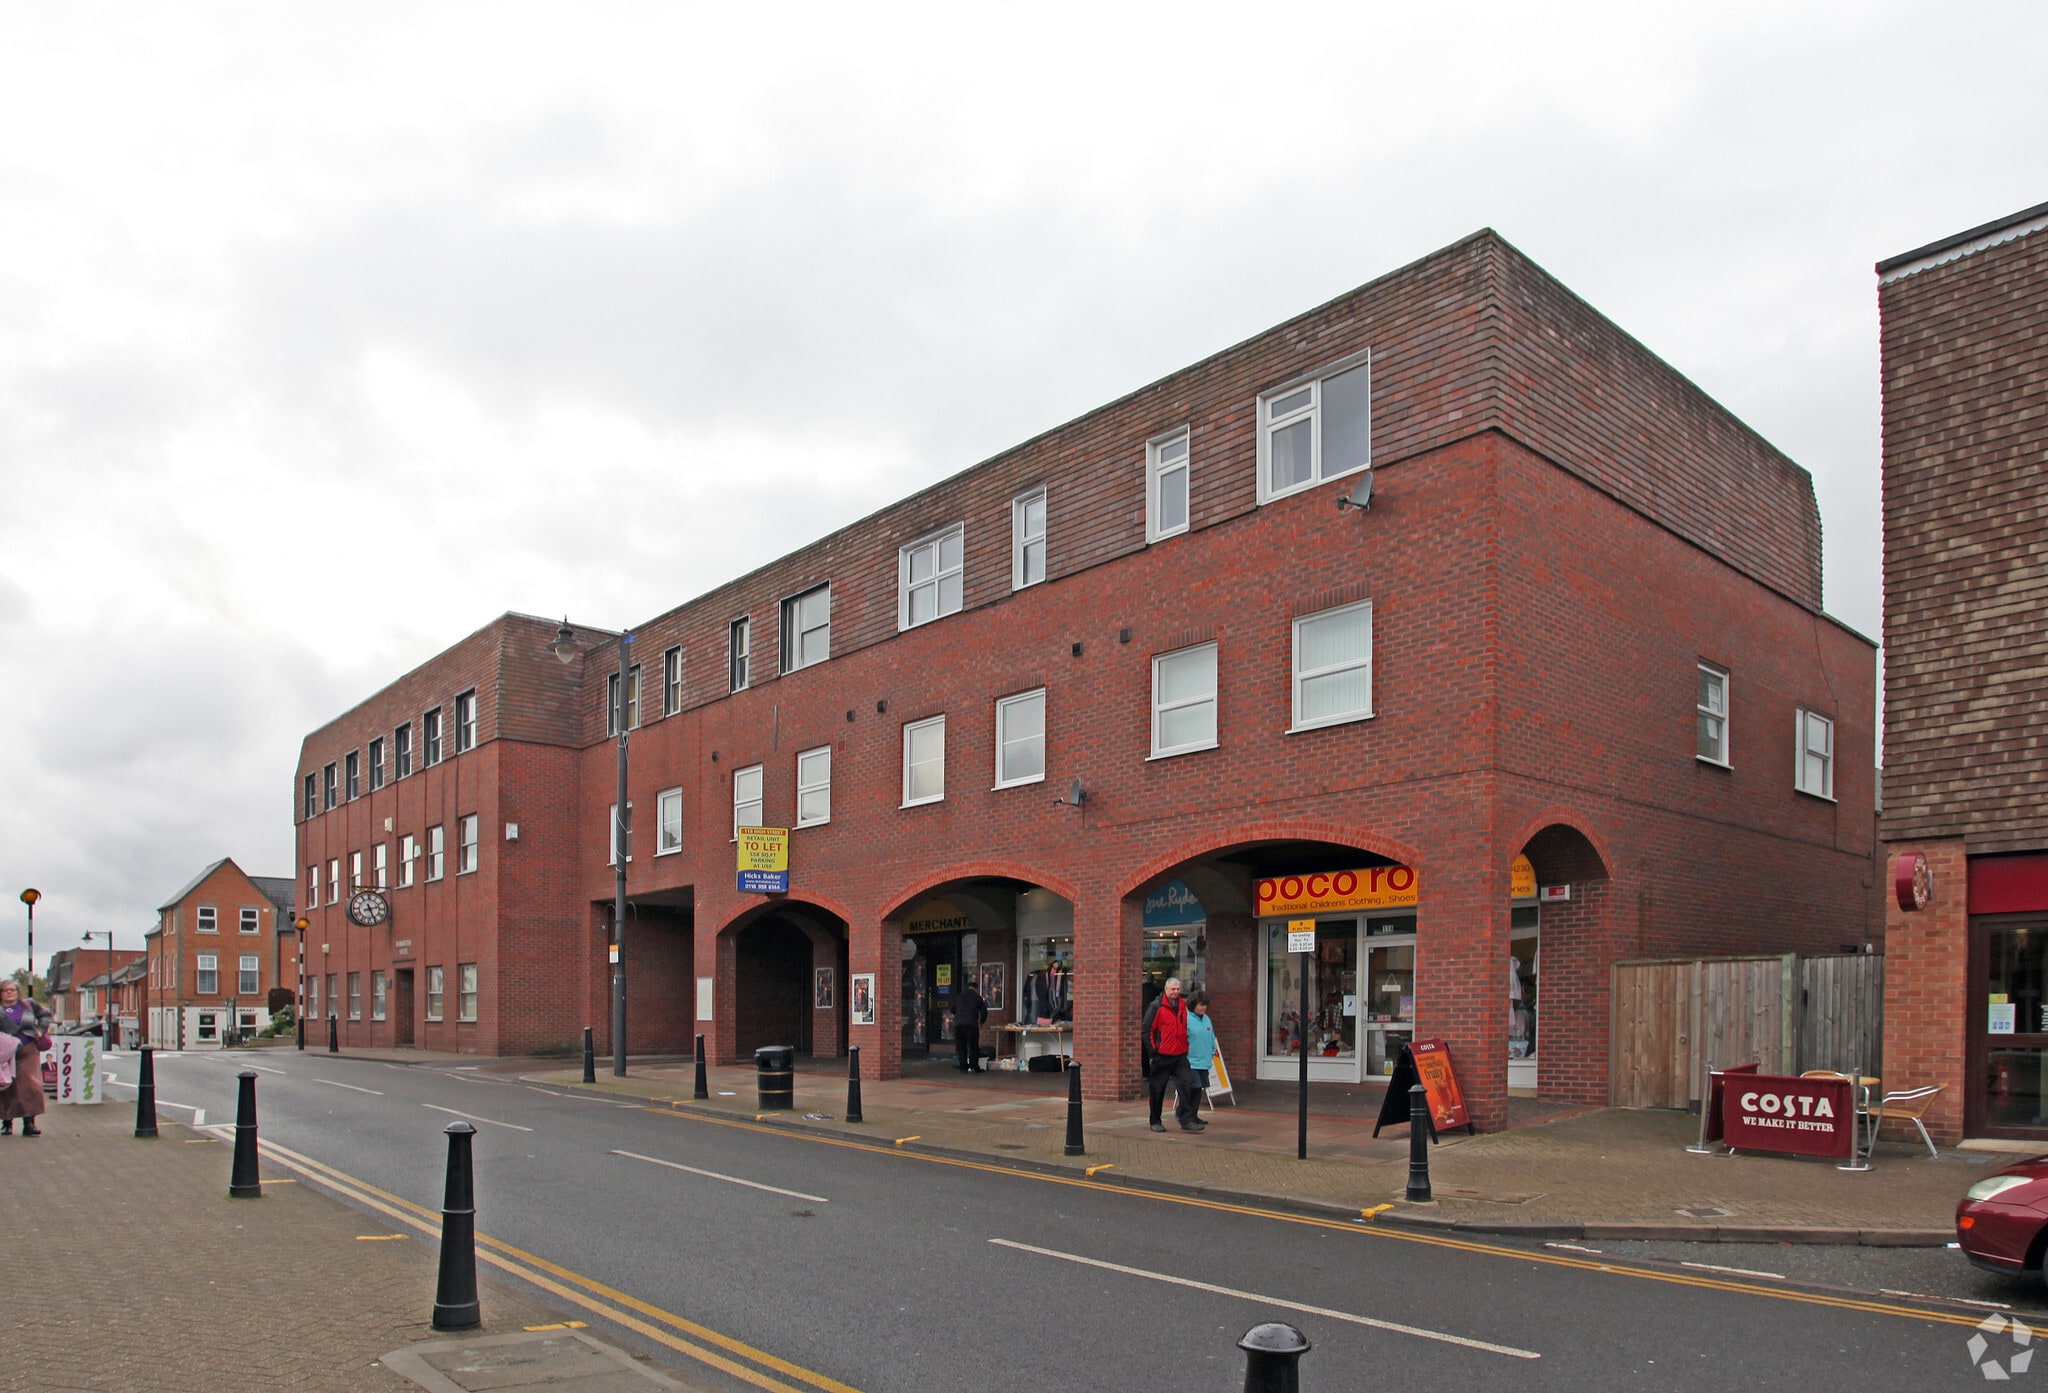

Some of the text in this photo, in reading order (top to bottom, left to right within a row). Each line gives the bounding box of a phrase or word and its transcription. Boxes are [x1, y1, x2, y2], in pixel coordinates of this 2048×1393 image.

[744, 842, 783, 852] TO LET
[1254, 870, 1358, 917] poco
[1511, 884, 1530, 892] ries
[1271, 902, 1307, 912] Traditional
[1310, 899, 1346, 909] Childrens
[1389, 894, 1416, 903] Shoes
[1420, 1043, 1436, 1051] COSTA
[62, 1042, 72, 1098] TOOLS
[1740, 1092, 1835, 1118] COSTA
[1742, 1116, 1835, 1132] WE MAKE IT BETTER
